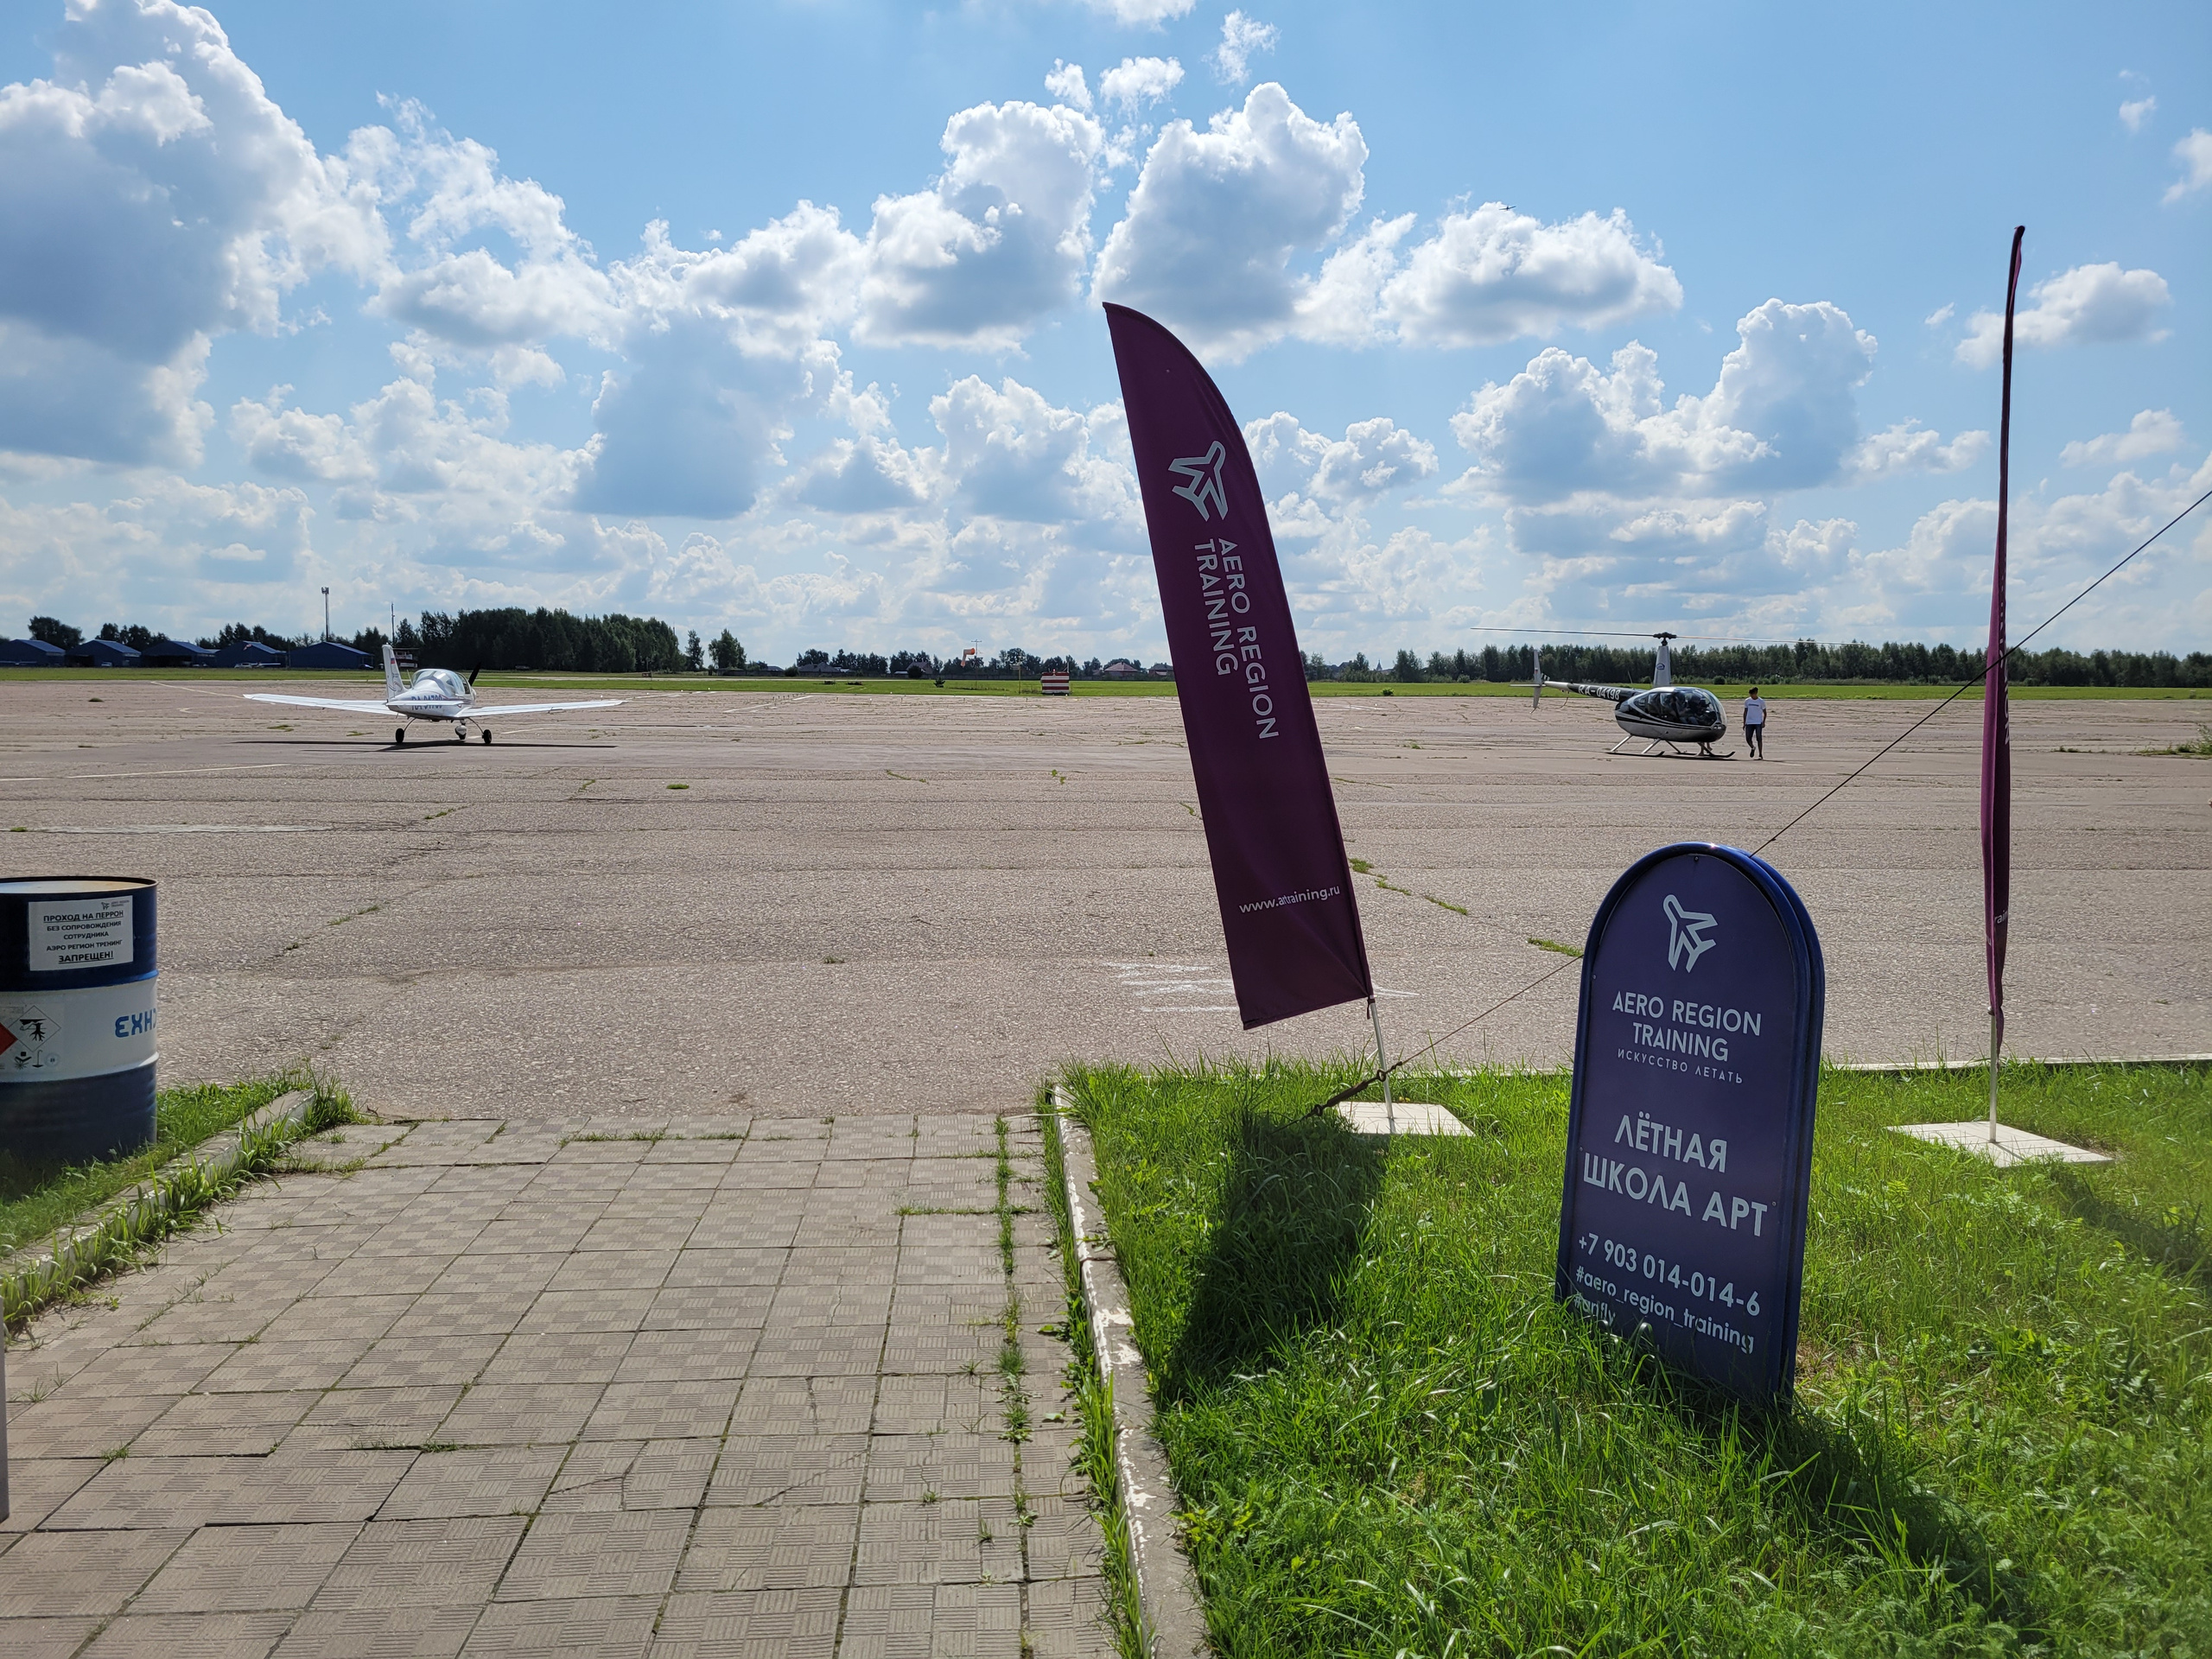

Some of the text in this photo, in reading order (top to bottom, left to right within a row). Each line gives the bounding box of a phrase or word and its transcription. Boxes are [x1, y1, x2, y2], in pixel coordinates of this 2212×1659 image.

[1194, 538, 1238, 676] TRAINING
[1218, 537, 1280, 739] AERO REGION
[1578, 684, 1621, 701] RA-04198
[43, 913, 81, 922] ПРОХОД
[95, 910, 124, 918] ПЕРРОН
[61, 920, 122, 931] СОПРОВОЖДЕНИЯ
[63, 931, 109, 940] СОТРУДНИКА
[59, 950, 113, 963] ЗАПРЕЩЕН!
[67, 942, 95, 950] РЕГИОН
[96, 939, 123, 948] ТРЕНИНГ
[1612, 991, 1762, 1036] AERO REGION
[1632, 1021, 1728, 1062] TRAINING
[1618, 1048, 1743, 1084] ИСКУССТВО ЛЕТАТЬ
[1614, 1110, 1727, 1173] ЛЁТНАЯ
[1583, 1152, 1768, 1236] ШКОЛА АРТ
[1579, 1233, 1761, 1316] +7 903 014-014-6
[1575, 1265, 1754, 1355] #aero_region_training
